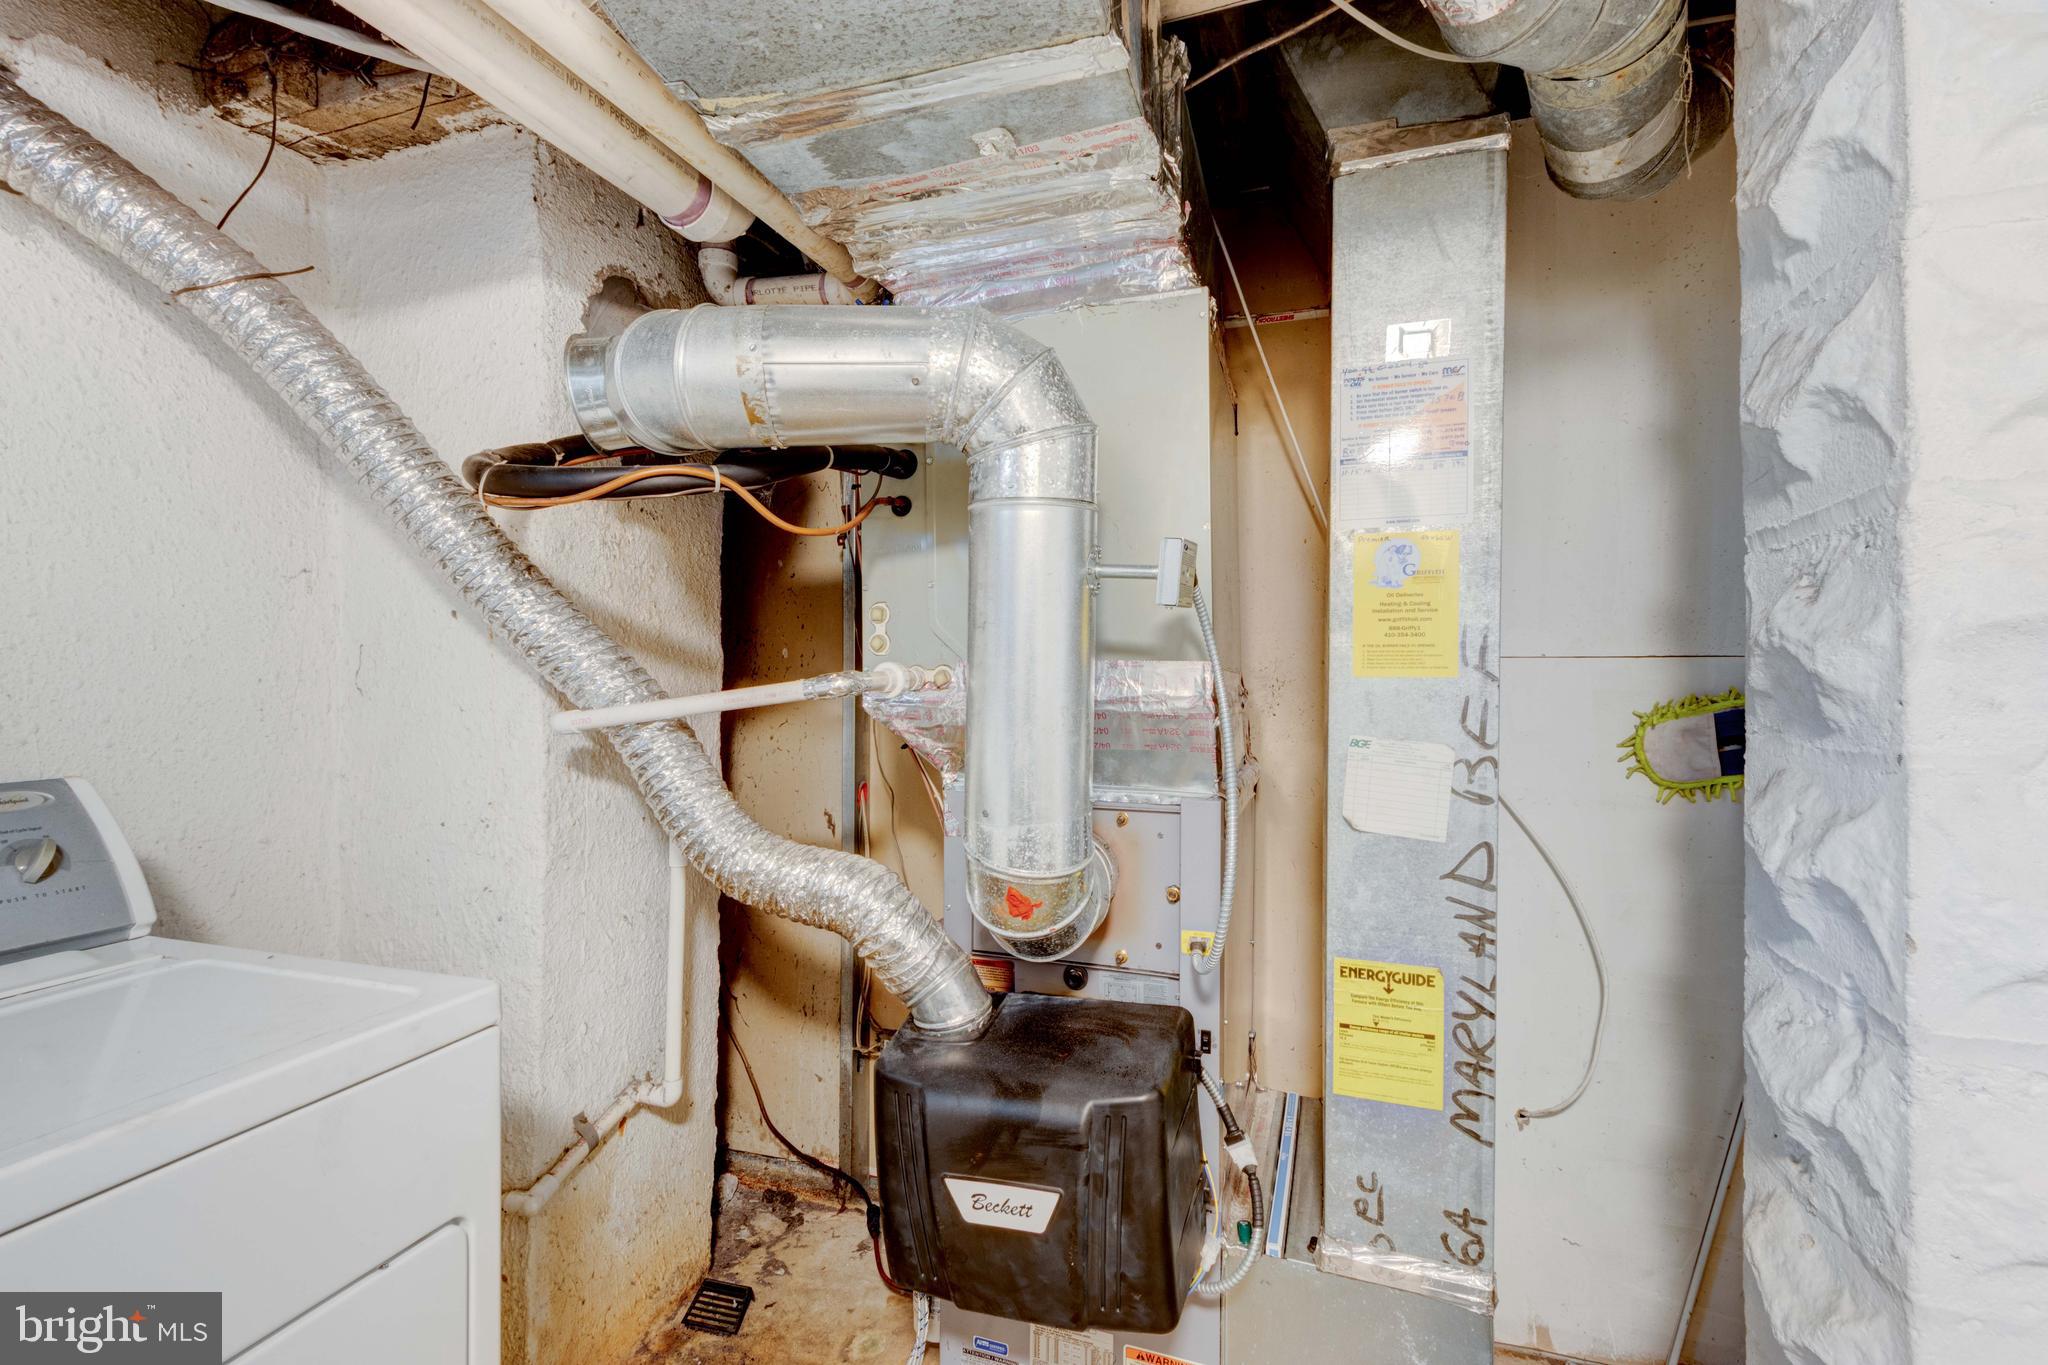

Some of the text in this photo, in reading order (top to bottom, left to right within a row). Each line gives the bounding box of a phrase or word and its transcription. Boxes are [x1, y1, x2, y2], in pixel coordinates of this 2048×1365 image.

[566, 73, 649, 144] NOT FOR PRESSURE
[793, 284, 817, 292] PIPE
[1349, 739, 1372, 749] BGE
[55, 884, 87, 895] START
[1339, 966, 1436, 988] ENERGYGUIDE
[1440, 841, 1497, 1149] MARYLAND
[970, 1193, 1033, 1218] Beckett
